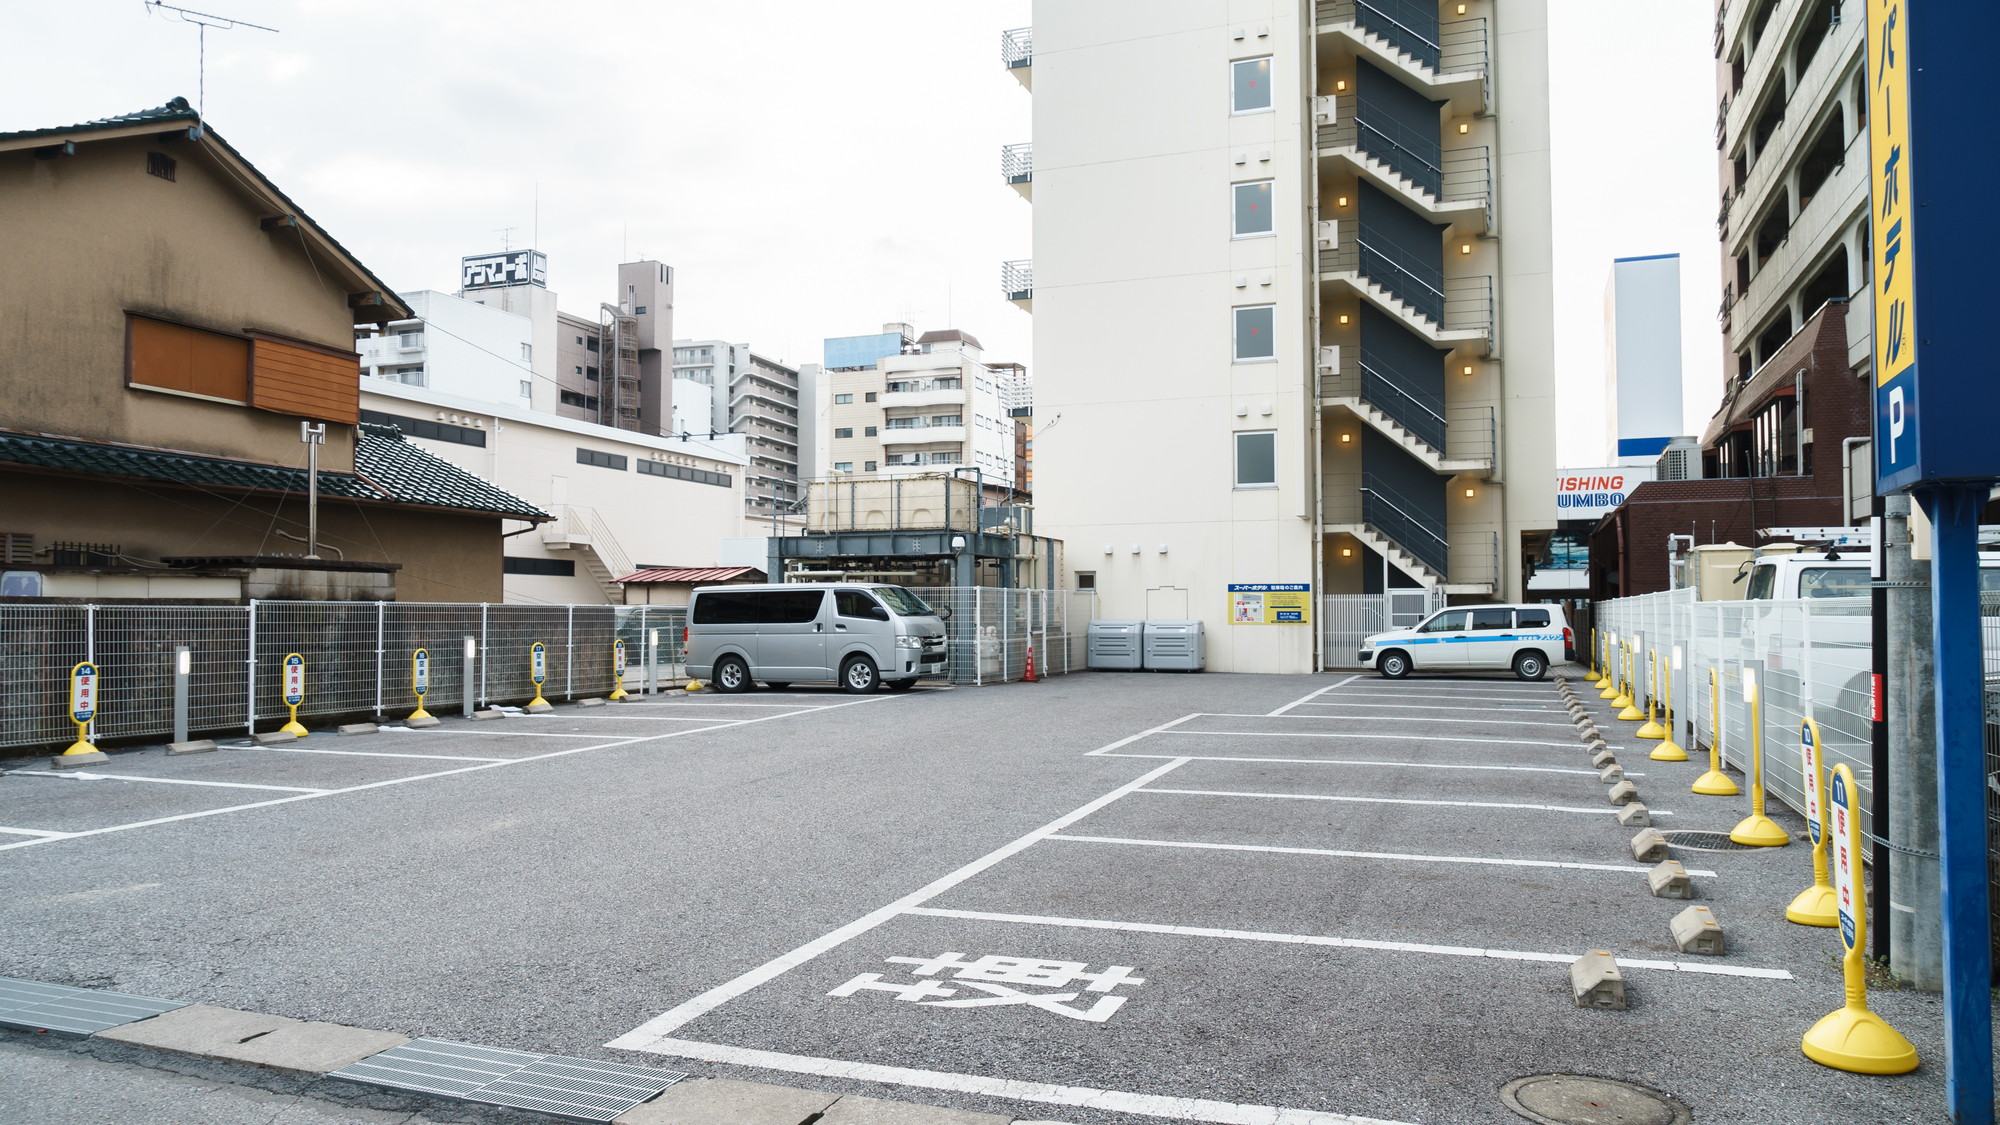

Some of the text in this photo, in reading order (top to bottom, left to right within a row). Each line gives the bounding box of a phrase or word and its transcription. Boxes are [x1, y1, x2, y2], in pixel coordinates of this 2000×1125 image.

[1878, 0, 1905, 372] パーホテル
[1889, 386, 1905, 465] P
[1556, 475, 1624, 491] ISHING
[1557, 492, 1625, 508] UMBO
[80, 676, 90, 710] 使用中
[81, 667, 91, 675] 14
[1806, 747, 1816, 818] 使用中
[1836, 780, 1844, 803] 11
[1838, 807, 1850, 911] 使用中
[826, 951, 1147, 1023] 軽
